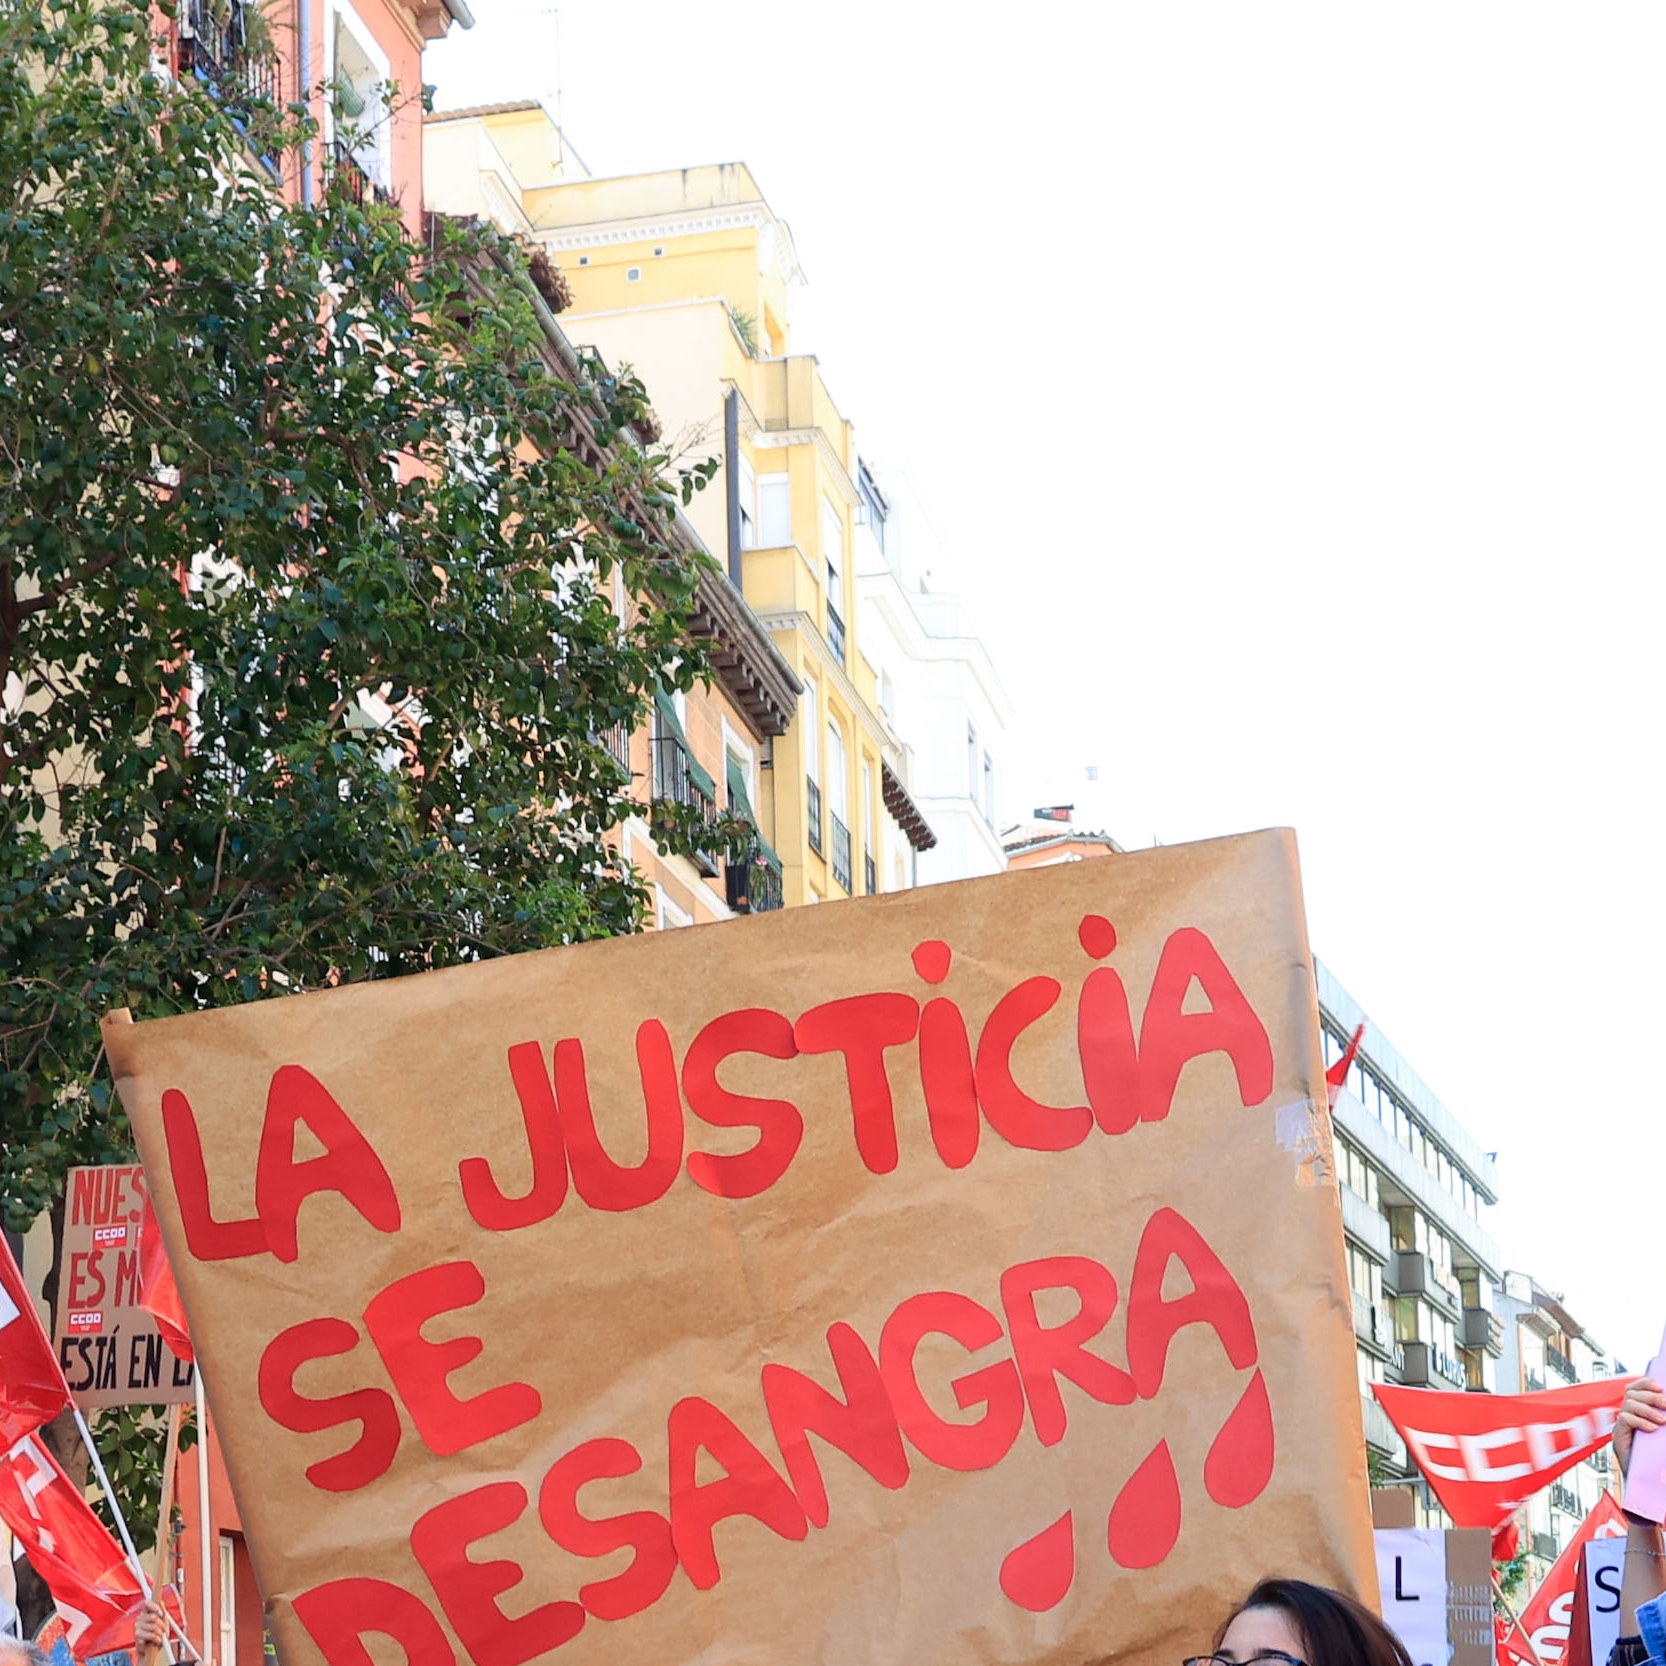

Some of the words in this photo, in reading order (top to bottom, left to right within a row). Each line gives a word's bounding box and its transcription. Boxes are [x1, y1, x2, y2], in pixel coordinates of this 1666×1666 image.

[161, 1063, 401, 1263] LA
[457, 914, 1275, 1232] JUSTICIA
[94, 1226, 127, 1241] CCOO
[67, 1250, 107, 1310] ES
[70, 1312, 103, 1325] CCOO
[60, 1325, 120, 1392] ESTÁ
[128, 1334, 162, 1388] EN
[257, 1260, 545, 1492] SE
